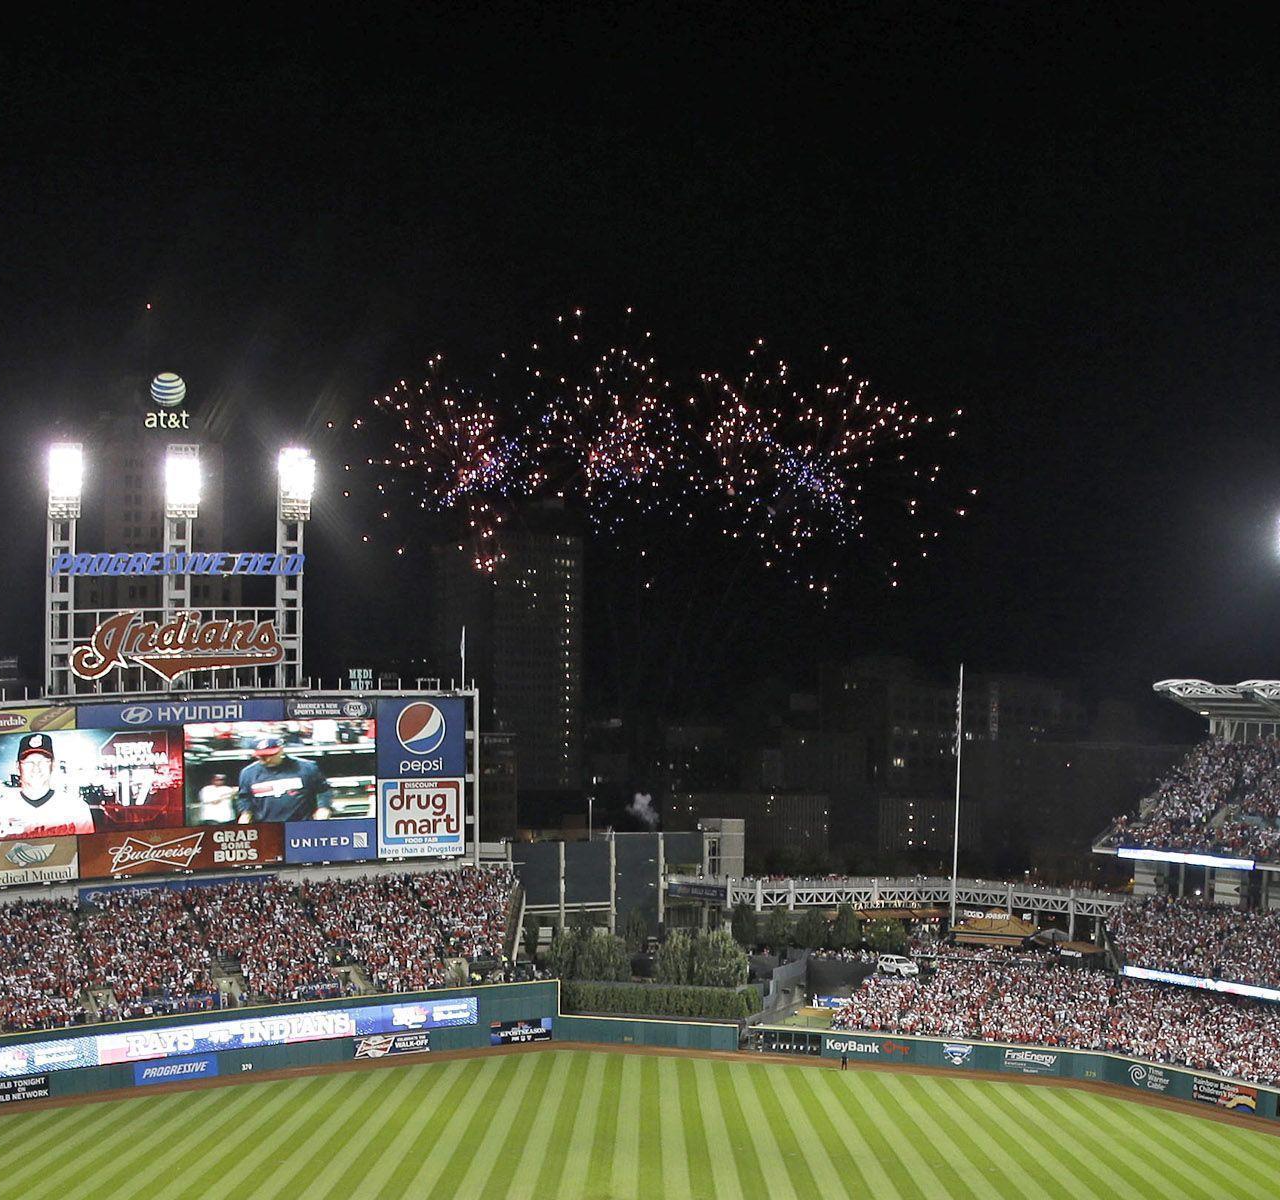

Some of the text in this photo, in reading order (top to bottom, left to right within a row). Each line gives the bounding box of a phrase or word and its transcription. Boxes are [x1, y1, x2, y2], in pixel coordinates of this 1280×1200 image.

[145, 409, 190, 430] at&t
[51, 552, 306, 576] PROGRESSIVE FIELD
[70, 610, 285, 682] Indians
[157, 705, 243, 721] HYUNDAI
[399, 757, 443, 774] pepsi
[118, 769, 153, 807] 17
[389, 788, 447, 816] drug
[395, 814, 457, 835] mart
[212, 829, 258, 843] GRAB
[290, 836, 350, 848] UNITED
[220, 841, 250, 850] SOME
[380, 847, 400, 855] More
[401, 846, 419, 854] than
[427, 845, 463, 854] Drugstore
[108, 843, 202, 864] Budweiser
[213, 848, 259, 862] BUDS
[31, 867, 73, 881] Mutual
[126, 1029, 195, 1058] RAYS
[240, 1013, 351, 1043] INDIANS
[394, 1039, 428, 1048] WALK-OFF
[826, 1039, 880, 1053] KeyBank
[1004, 1049, 1057, 1065] FirstEnergy
[142, 1061, 208, 1079] PROGRESSIVE
[1147, 1067, 1164, 1076] Time
[13, 1077, 46, 1088] TONIGHT
[1146, 1081, 1165, 1091] Cable
[1147, 1074, 1170, 1085] Warner
[1193, 1077, 1219, 1089] Rainbow
[12, 1089, 49, 1100] NETWORK
